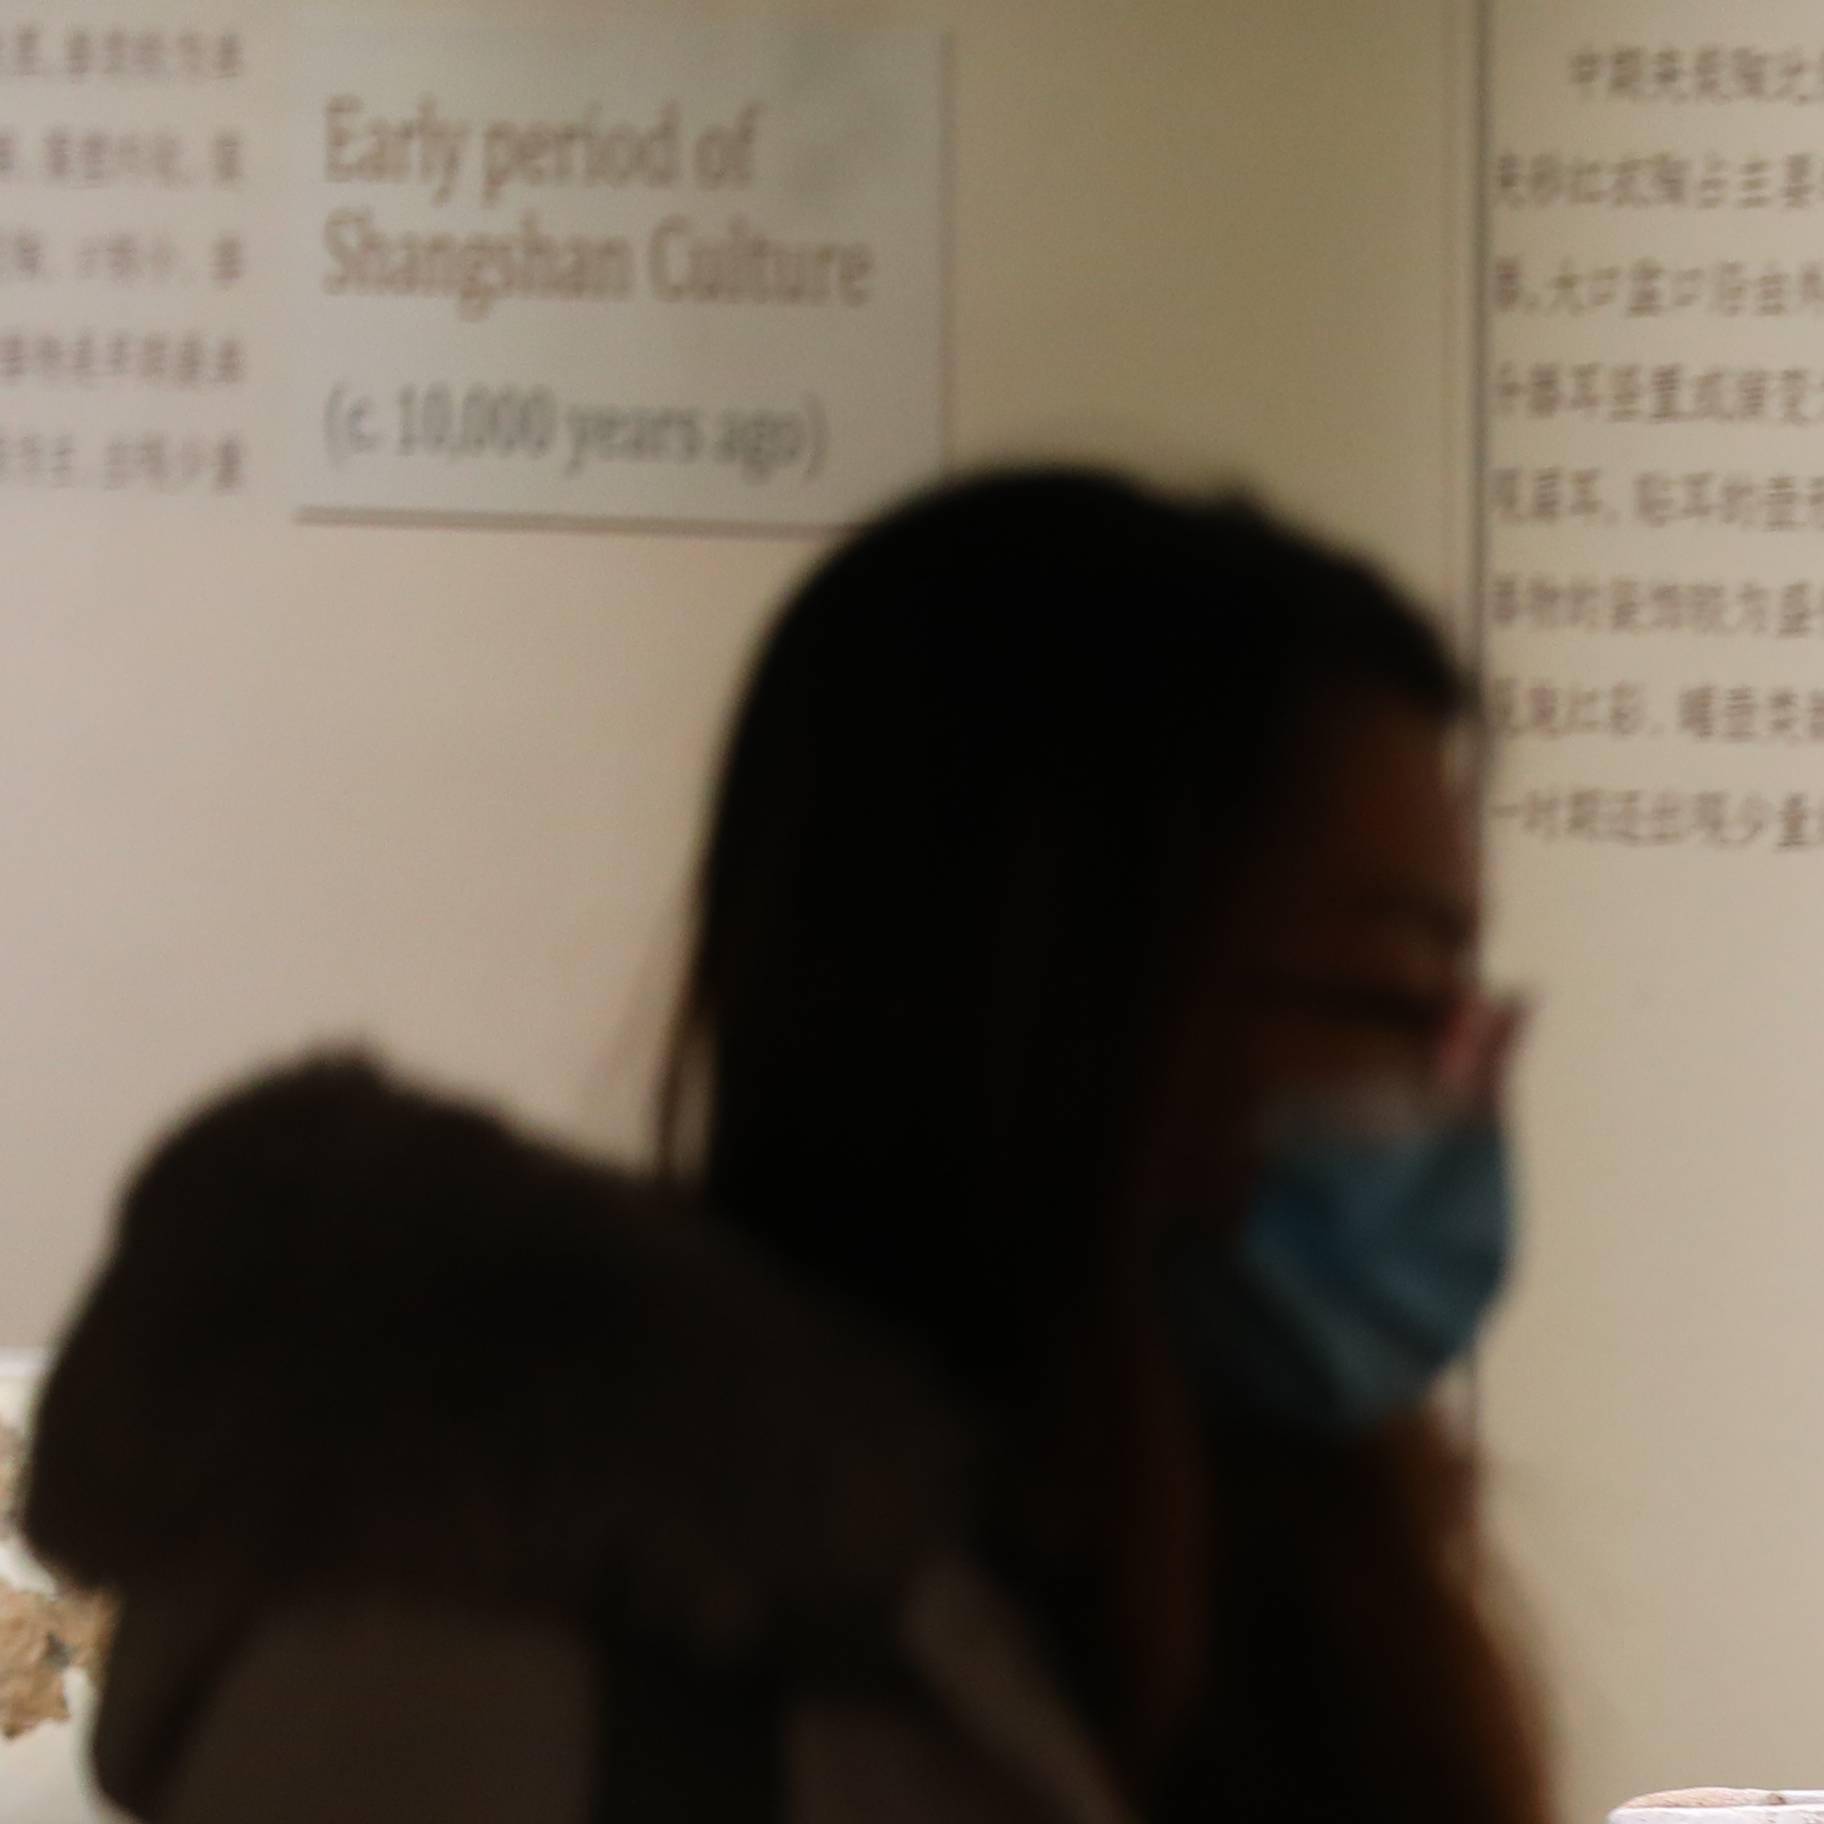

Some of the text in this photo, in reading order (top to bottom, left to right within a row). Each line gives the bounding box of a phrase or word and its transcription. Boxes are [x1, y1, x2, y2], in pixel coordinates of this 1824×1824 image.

[323, 95, 468, 203] Early
[482, 101, 681, 203] period
[694, 100, 764, 189] of
[323, 205, 632, 320] Shangshan
[649, 215, 875, 308] Culture
[562, 402, 704, 476] years
